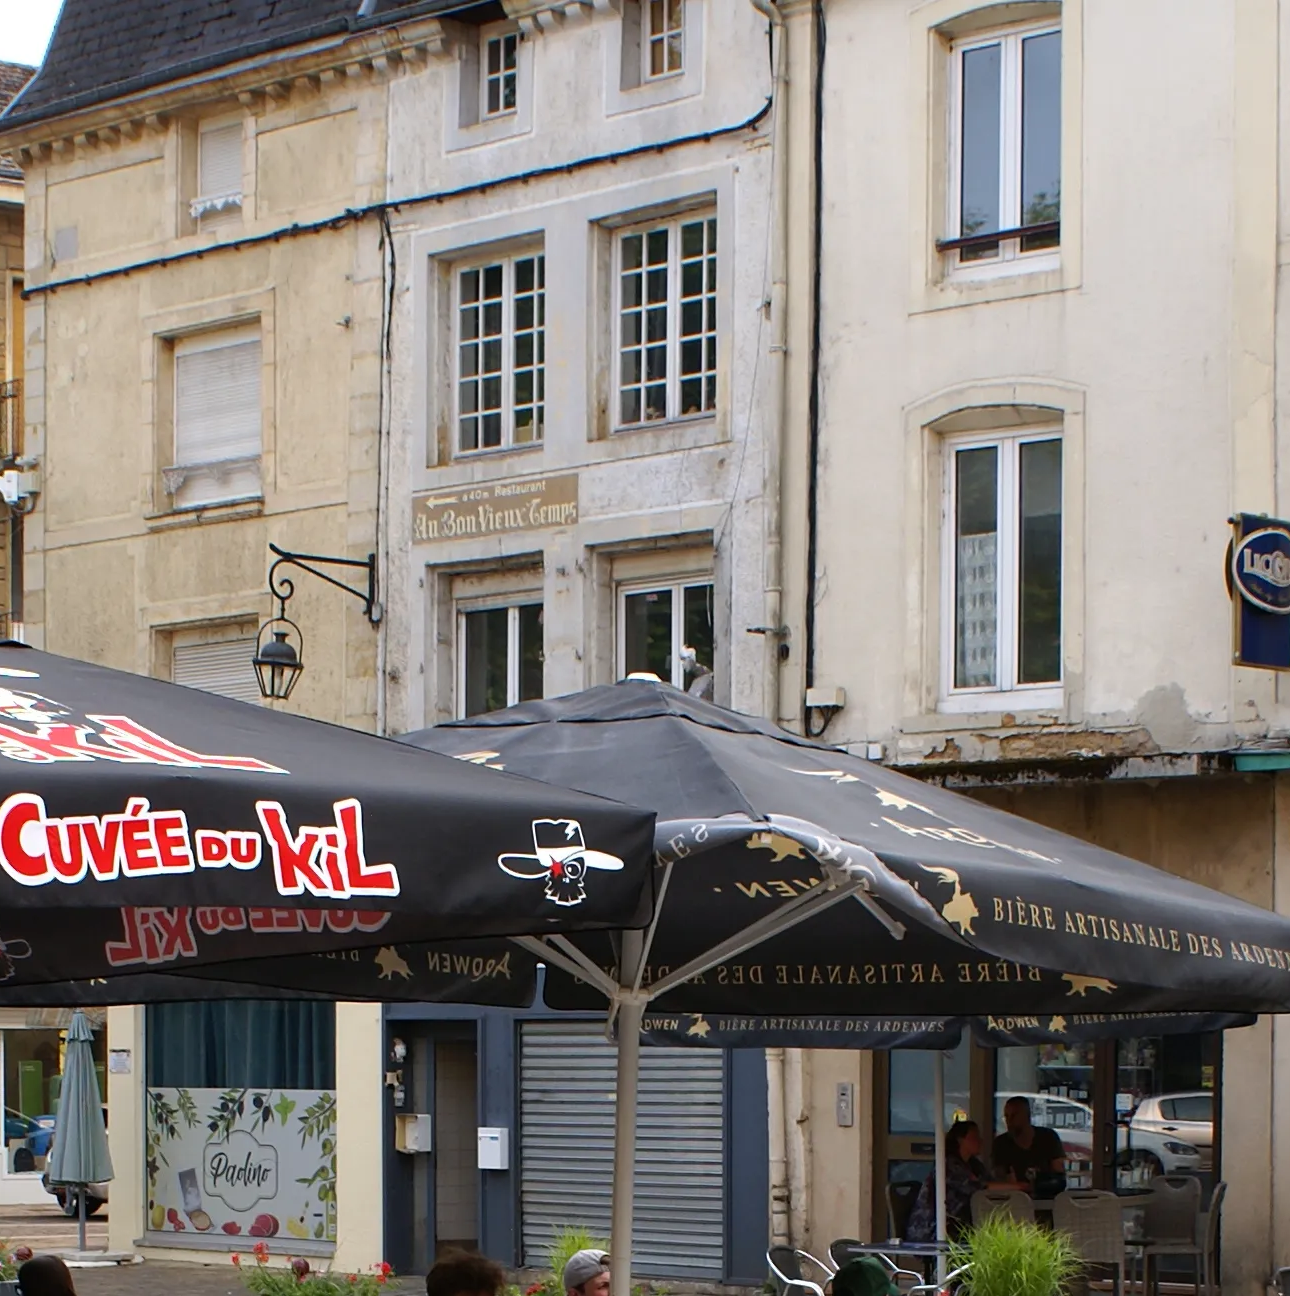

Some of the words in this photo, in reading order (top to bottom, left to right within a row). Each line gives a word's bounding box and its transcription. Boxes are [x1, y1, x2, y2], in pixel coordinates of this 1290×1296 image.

[494, 480, 546, 497] Restaurant
[414, 513, 439, 540] Au
[441, 509, 476, 537] Bon
[478, 503, 527, 532] Vieux
[526, 498, 577, 525] Temps
[195, 829, 262, 870] DU
[993, 896, 1056, 930] BIÈRE
[1065, 911, 1181, 952] ARTISANALE
[1186, 932, 1224, 958] DES
[639, 1018, 679, 1035] DWEN
[719, 1016, 755, 1032] BIÈRE
[760, 1018, 840, 1033] ARTISANALE
[845, 1020, 869, 1033] DES
[873, 1021, 946, 1034] ARDENNES
[986, 1014, 1040, 1033] ARDWEN
